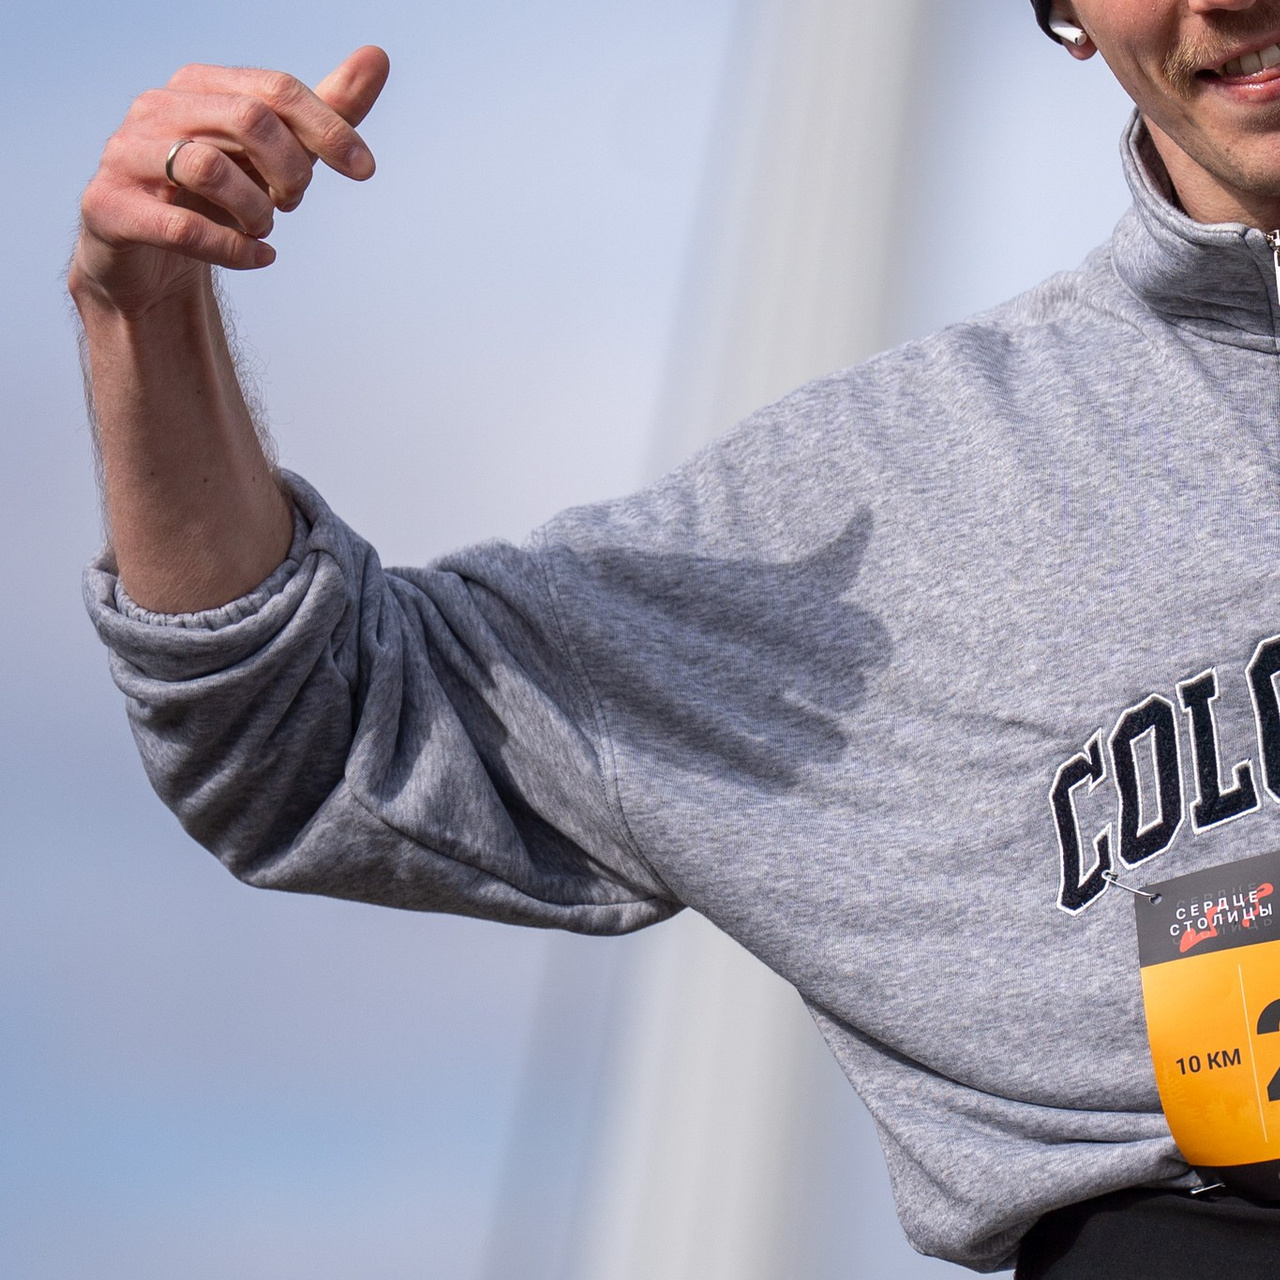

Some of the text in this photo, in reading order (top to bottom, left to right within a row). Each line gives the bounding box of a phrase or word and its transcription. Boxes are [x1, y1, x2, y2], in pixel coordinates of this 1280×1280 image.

[1169, 903, 1273, 936] СТОЛИЦЫ
[1176, 890, 1259, 920] СЕРДЦЕ
[1175, 1055, 1202, 1076] 10
